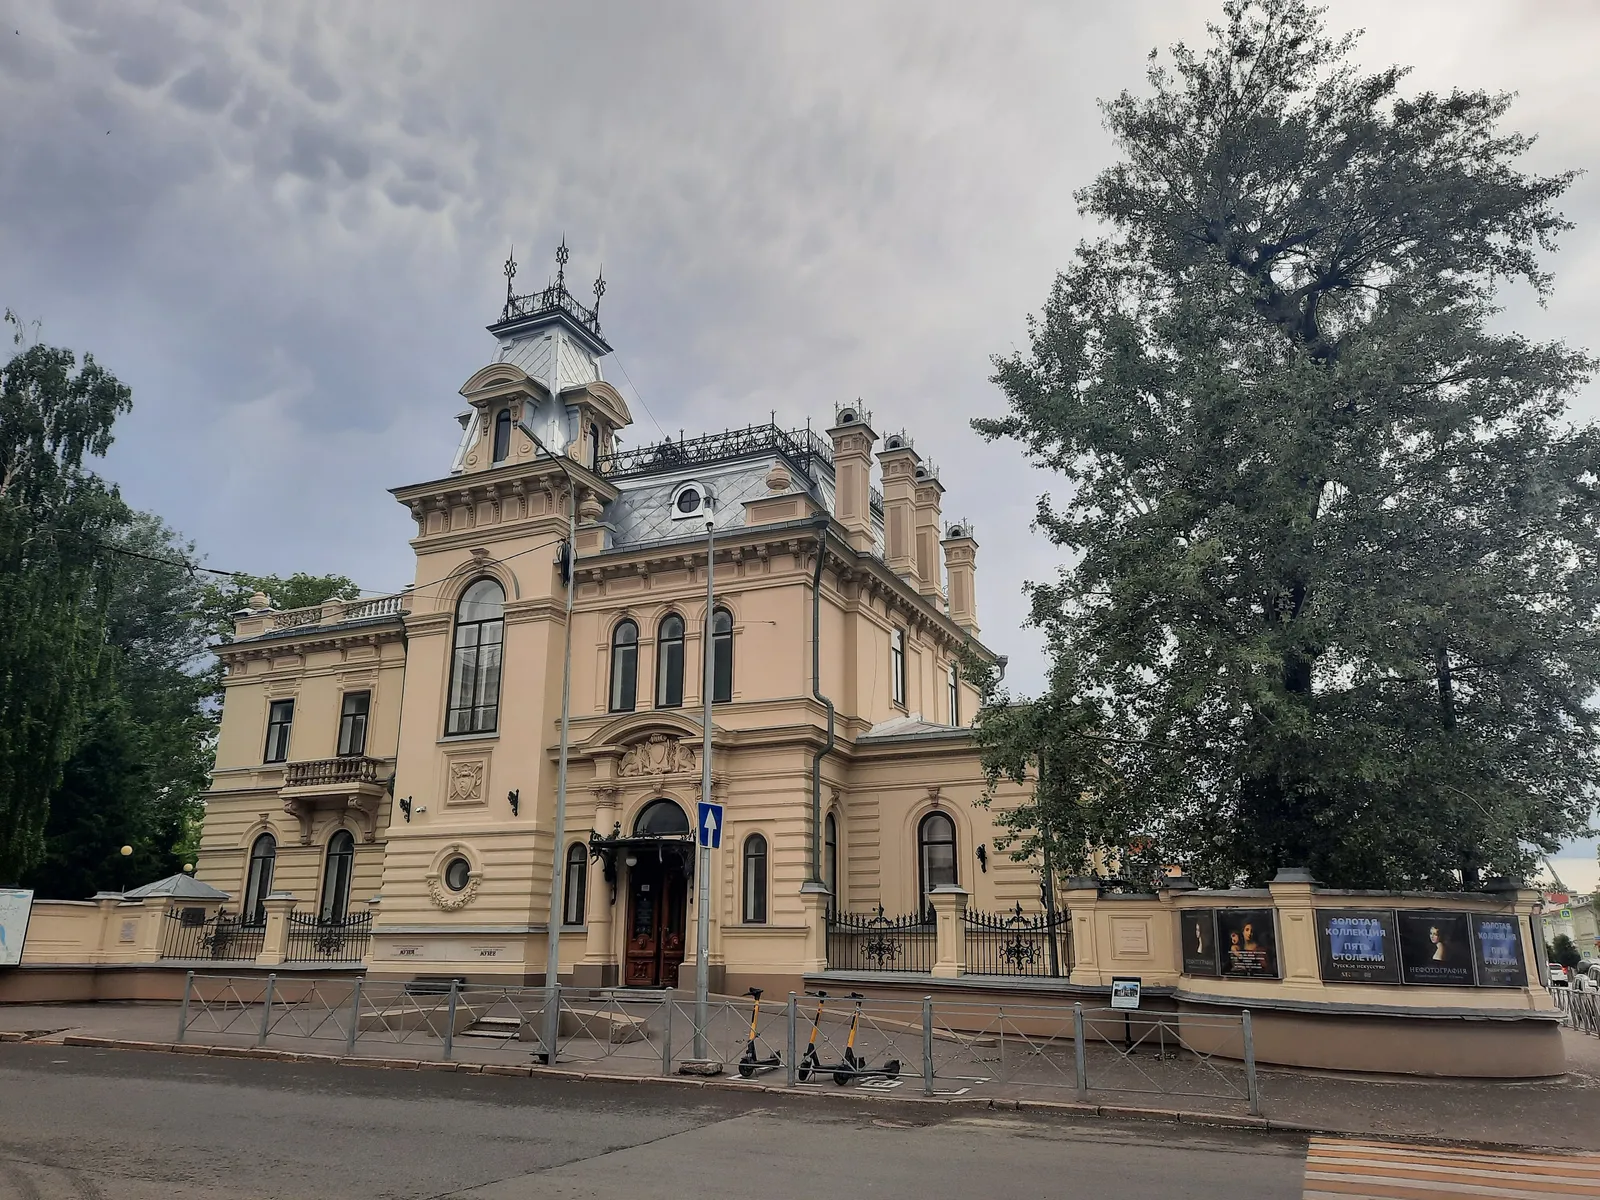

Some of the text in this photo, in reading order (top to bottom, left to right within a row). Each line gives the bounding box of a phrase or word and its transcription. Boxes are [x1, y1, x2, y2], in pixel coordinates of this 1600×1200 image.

[1331, 917, 1378, 926] ЗОЛОТАЯ
[1325, 928, 1386, 937] КОЛЛЕКЦИЯ
[1344, 942, 1371, 951] ПЯТЬ
[1332, 952, 1385, 962] СТОЛЕТИЙ
[1409, 966, 1468, 975] НЕФОТОГРАФИЯ
